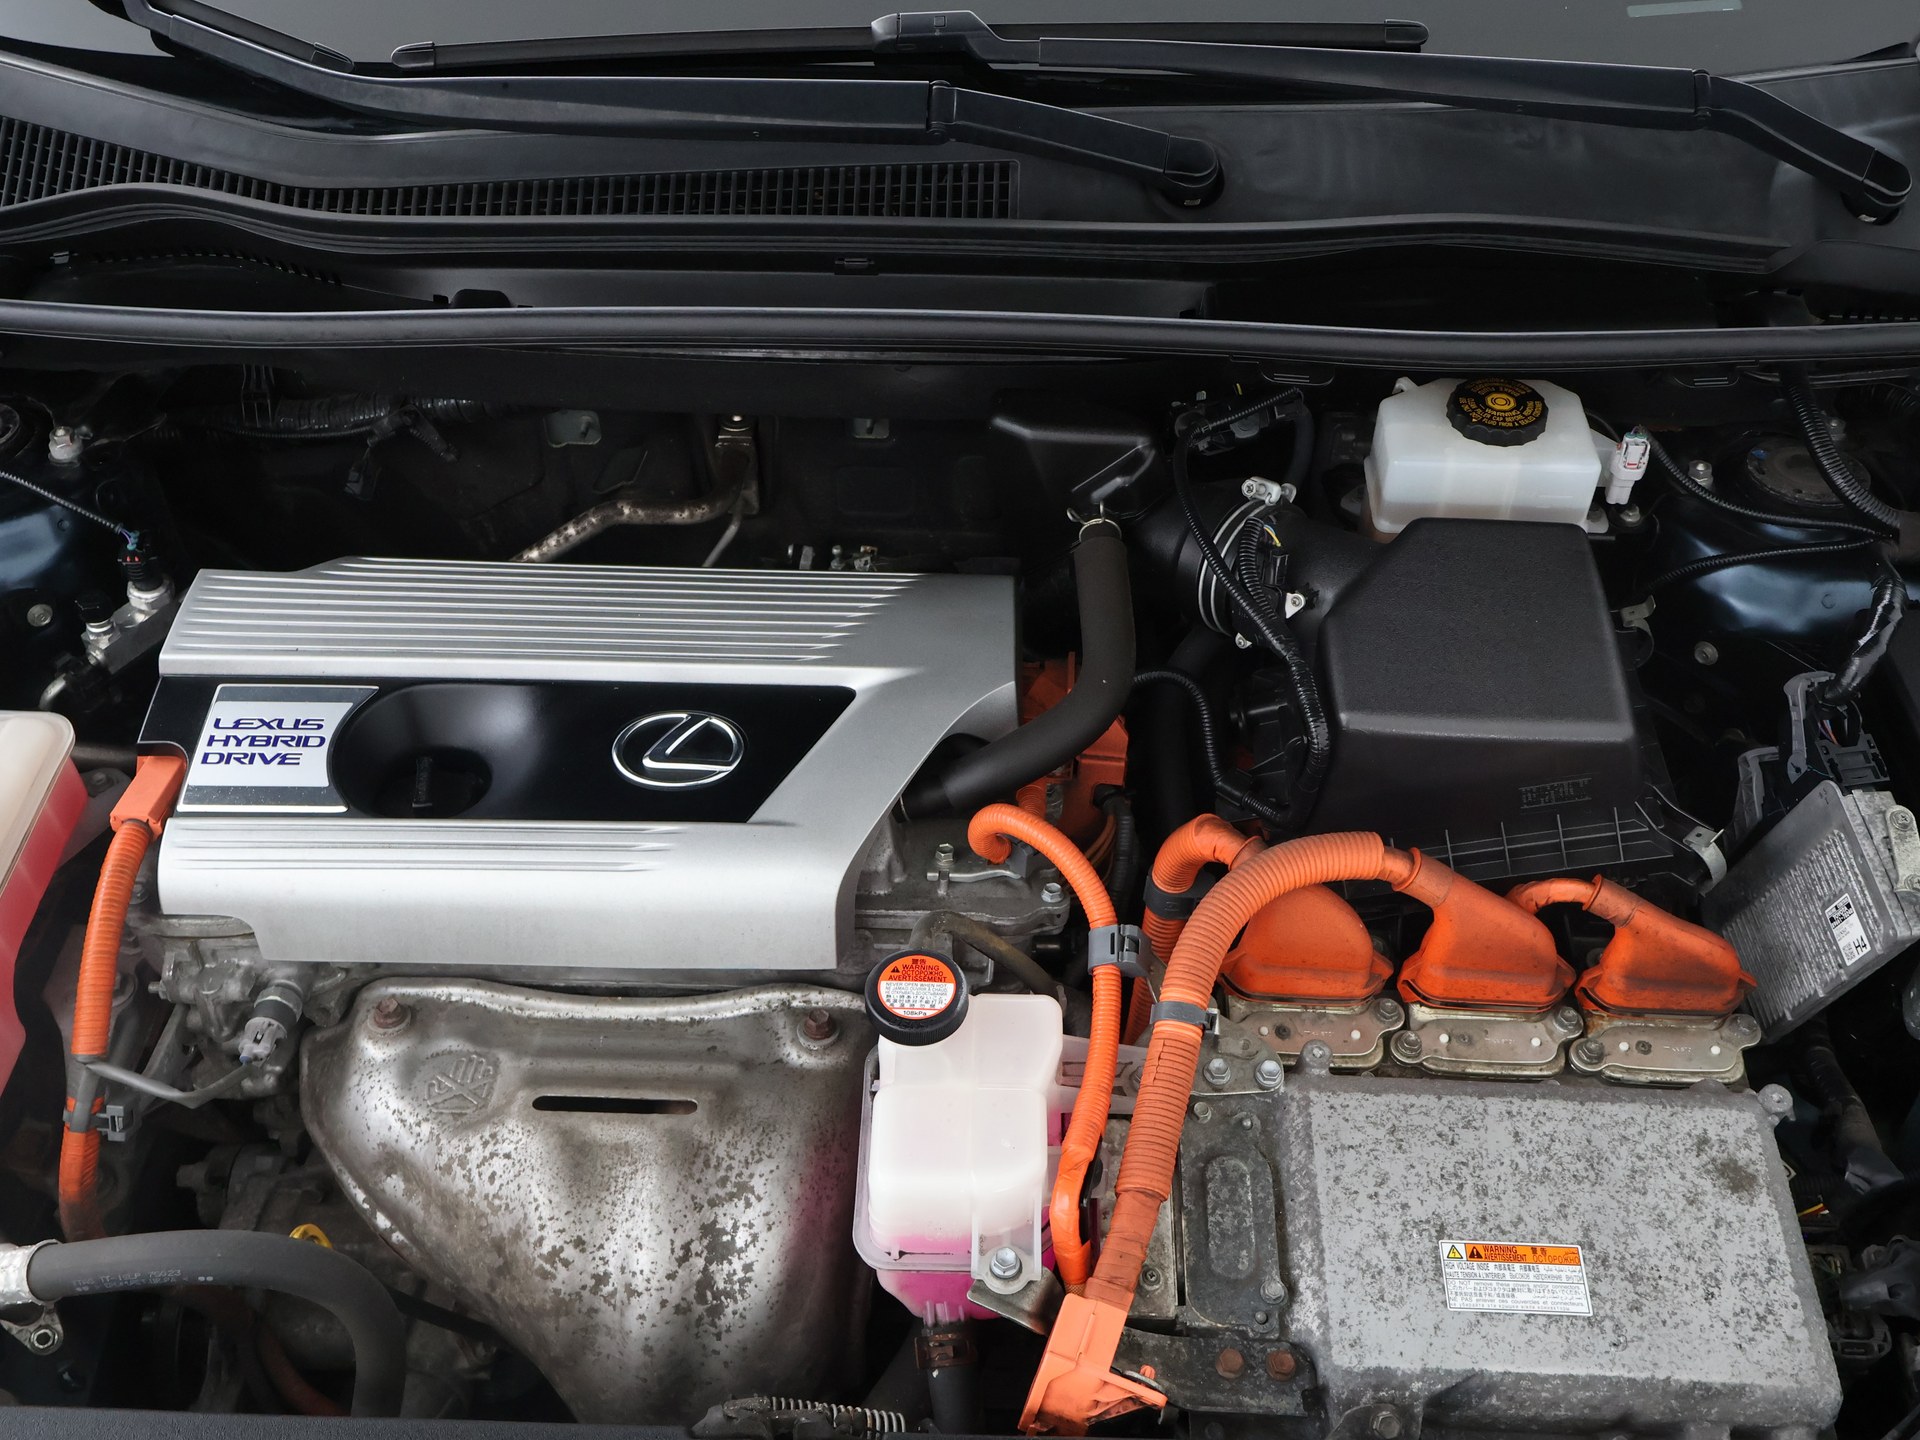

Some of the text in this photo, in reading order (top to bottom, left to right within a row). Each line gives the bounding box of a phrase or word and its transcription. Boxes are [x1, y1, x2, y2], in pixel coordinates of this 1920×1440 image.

[1485, 408, 1520, 417] WARNING
[213, 718, 325, 731] LEXUS
[206, 734, 327, 748] HYBRID
[200, 752, 303, 766] DRIVE
[1853, 935, 1868, 955] H4
[888, 974, 948, 982] AVERTISSEMENT
[1483, 1245, 1518, 1254] WARNING
[1484, 1253, 1527, 1262] AVERTISSEMENT
[1532, 1254, 1580, 1264] ОСТОРОЖНО
[1445, 1261, 1455, 1269] HIGH
[1457, 1262, 1475, 1270] VOLTAGE
